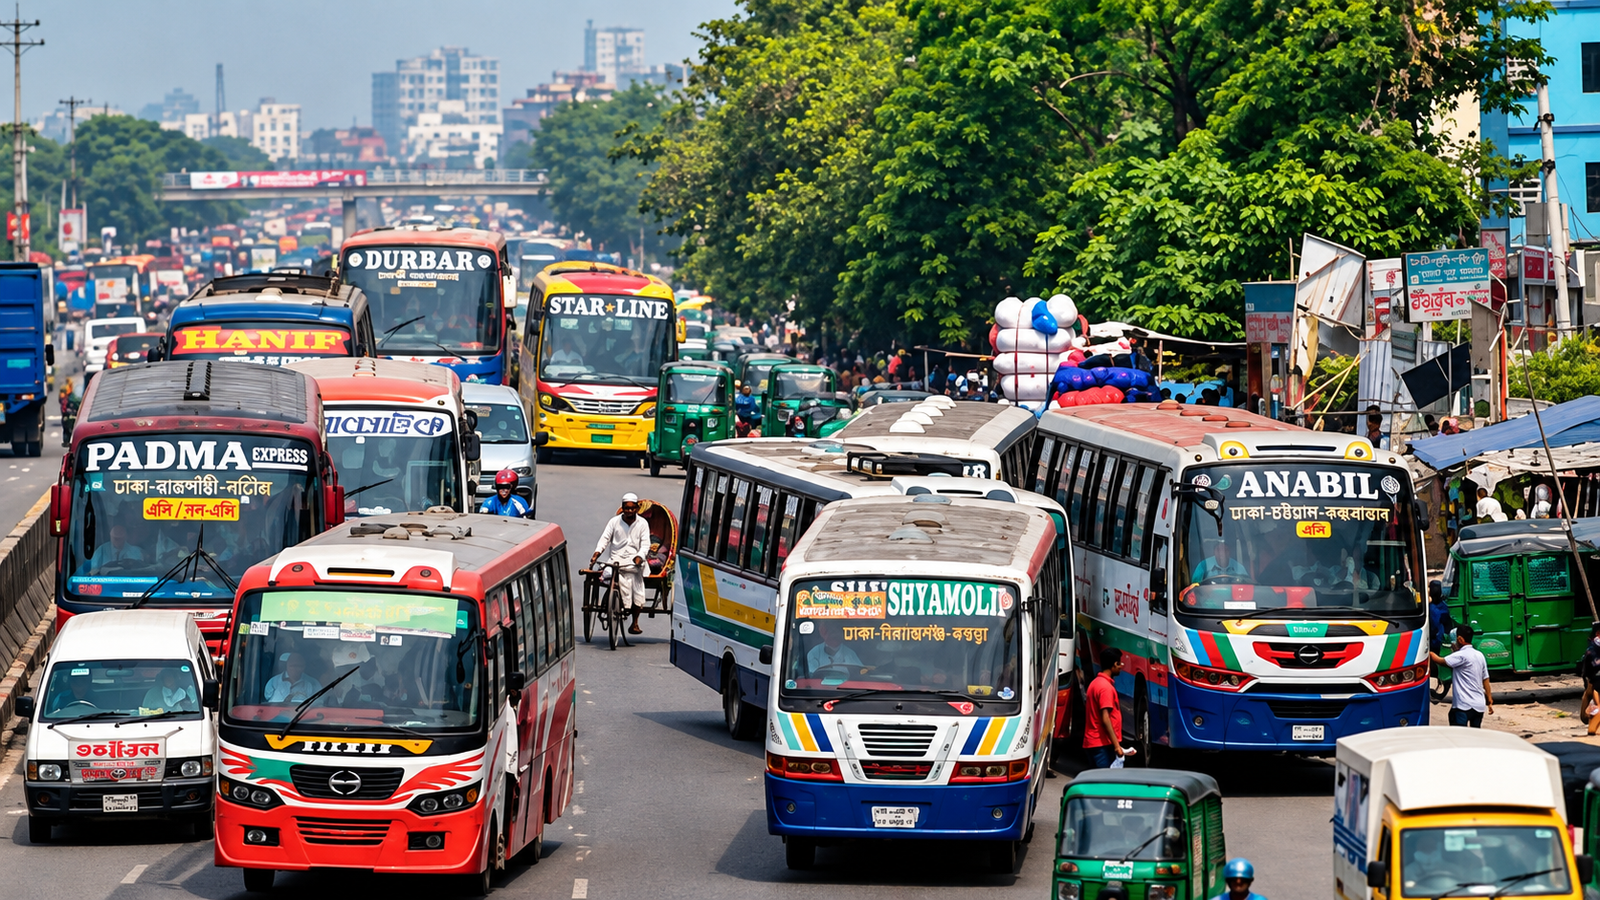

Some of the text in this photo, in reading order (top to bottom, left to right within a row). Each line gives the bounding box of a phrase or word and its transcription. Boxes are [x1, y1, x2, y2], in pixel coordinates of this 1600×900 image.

[365, 250, 475, 271] DURBAR
[549, 296, 669, 320] STAR LINE
[182, 330, 342, 350] HANIF
[85, 441, 308, 471] PADMA EXPRESS
[1236, 471, 1379, 500] ANABIL
